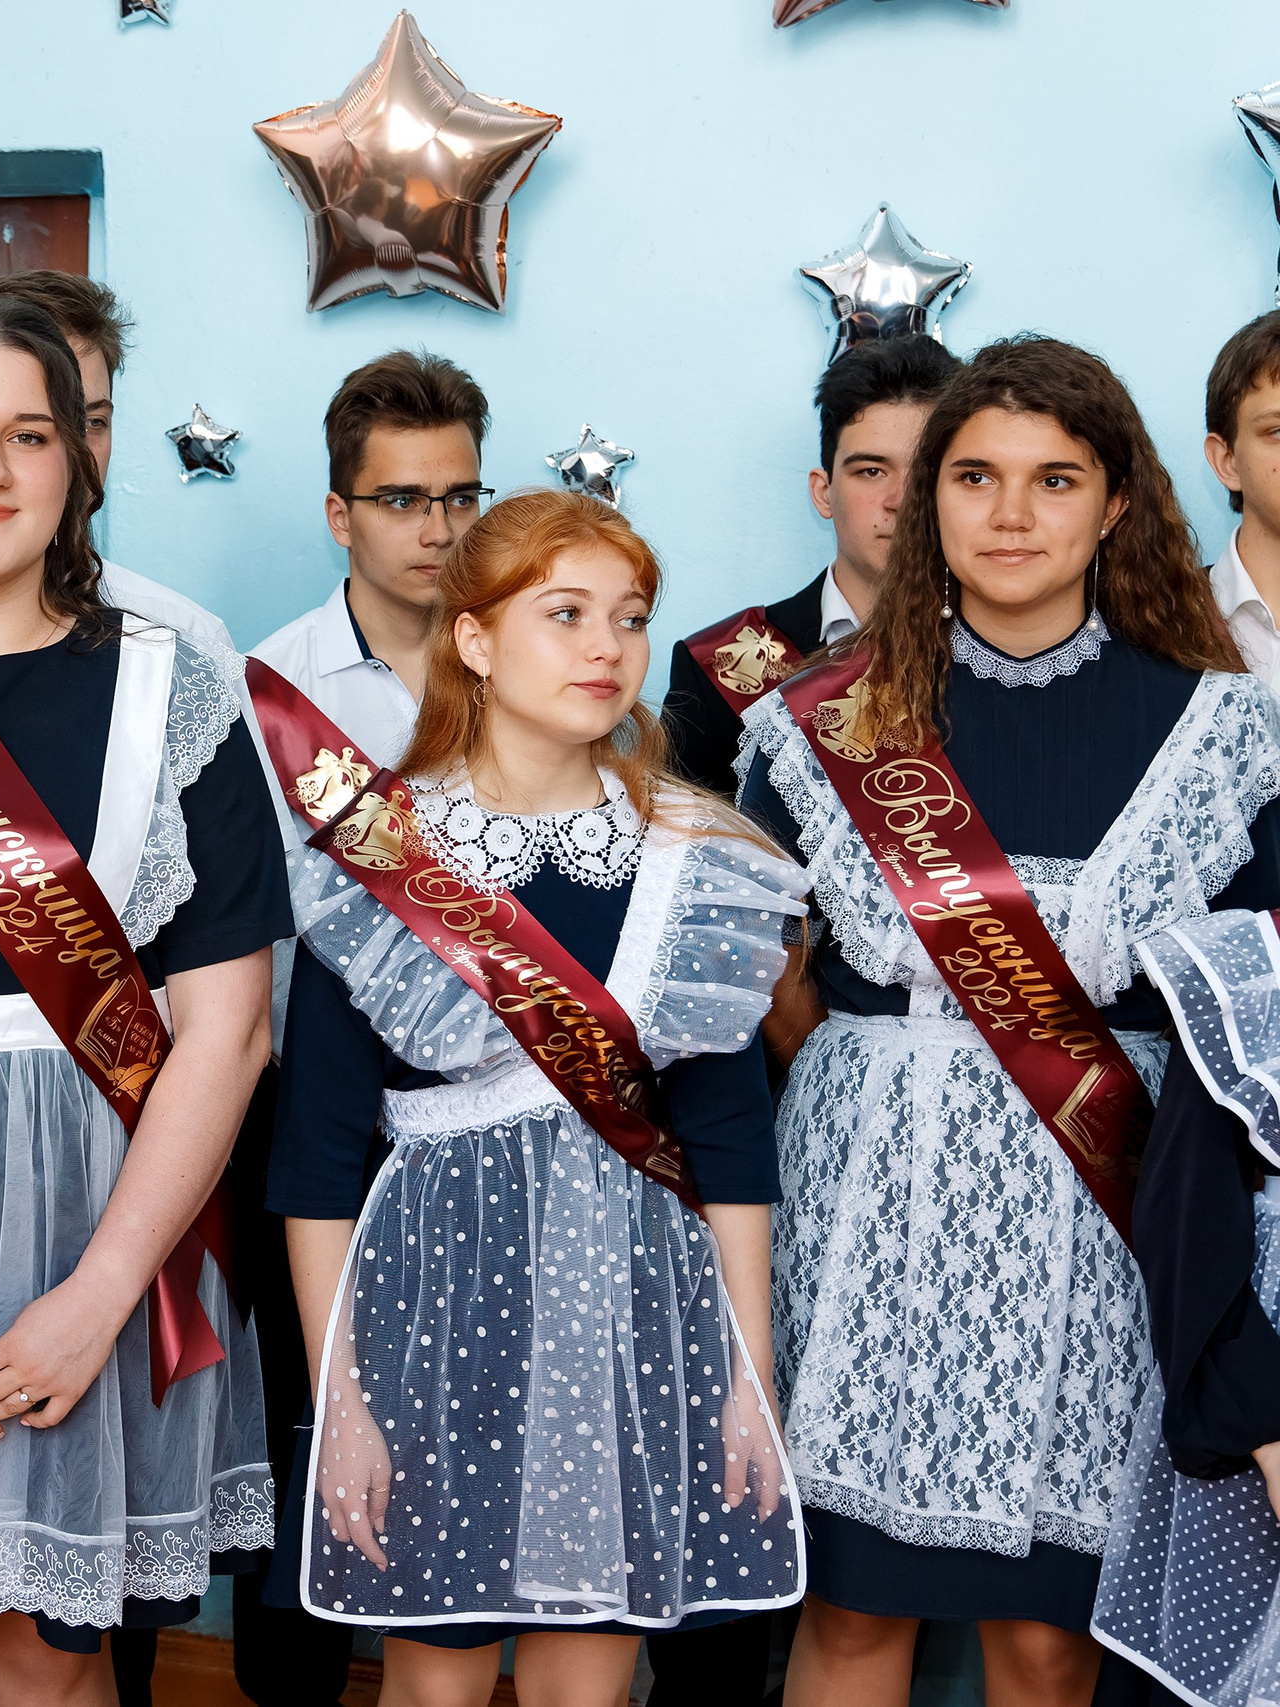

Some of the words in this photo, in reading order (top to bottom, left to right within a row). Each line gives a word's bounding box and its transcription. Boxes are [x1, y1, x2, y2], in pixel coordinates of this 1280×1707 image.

[860, 758, 1097, 1060] Выпускница
[939, 947, 1029, 1031] 2024
[531, 1031, 615, 1105] 2024
